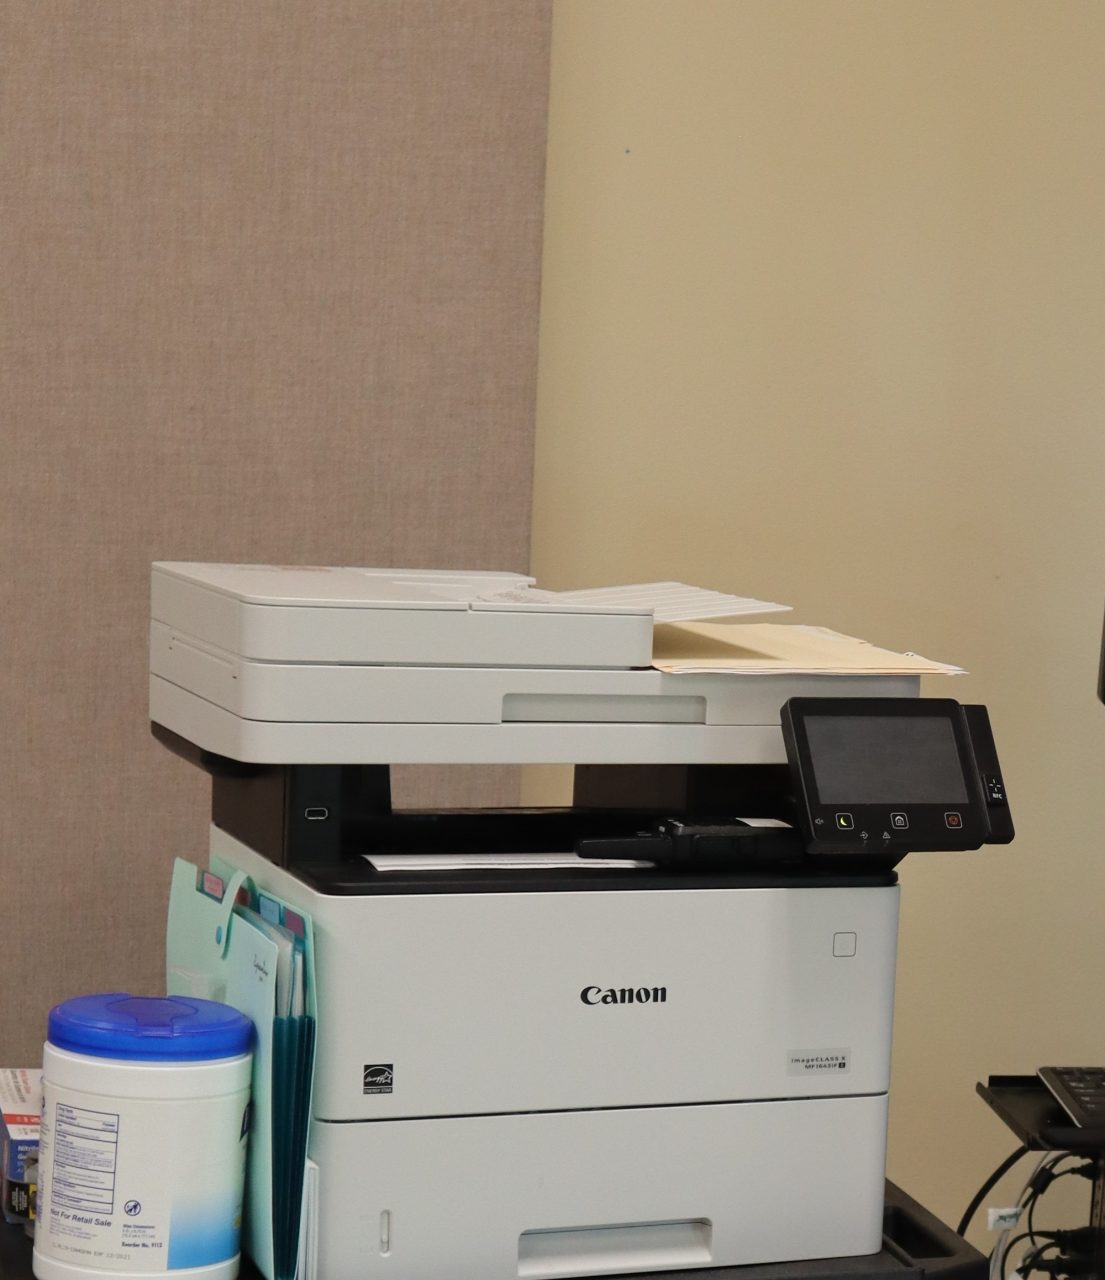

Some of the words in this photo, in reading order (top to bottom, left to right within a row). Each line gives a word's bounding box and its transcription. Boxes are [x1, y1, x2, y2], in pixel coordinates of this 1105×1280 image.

[580, 985, 667, 1005] Canon
[60, 1209, 71, 1221] For
[71, 1213, 93, 1225] Retail
[94, 1218, 112, 1228] Sale
